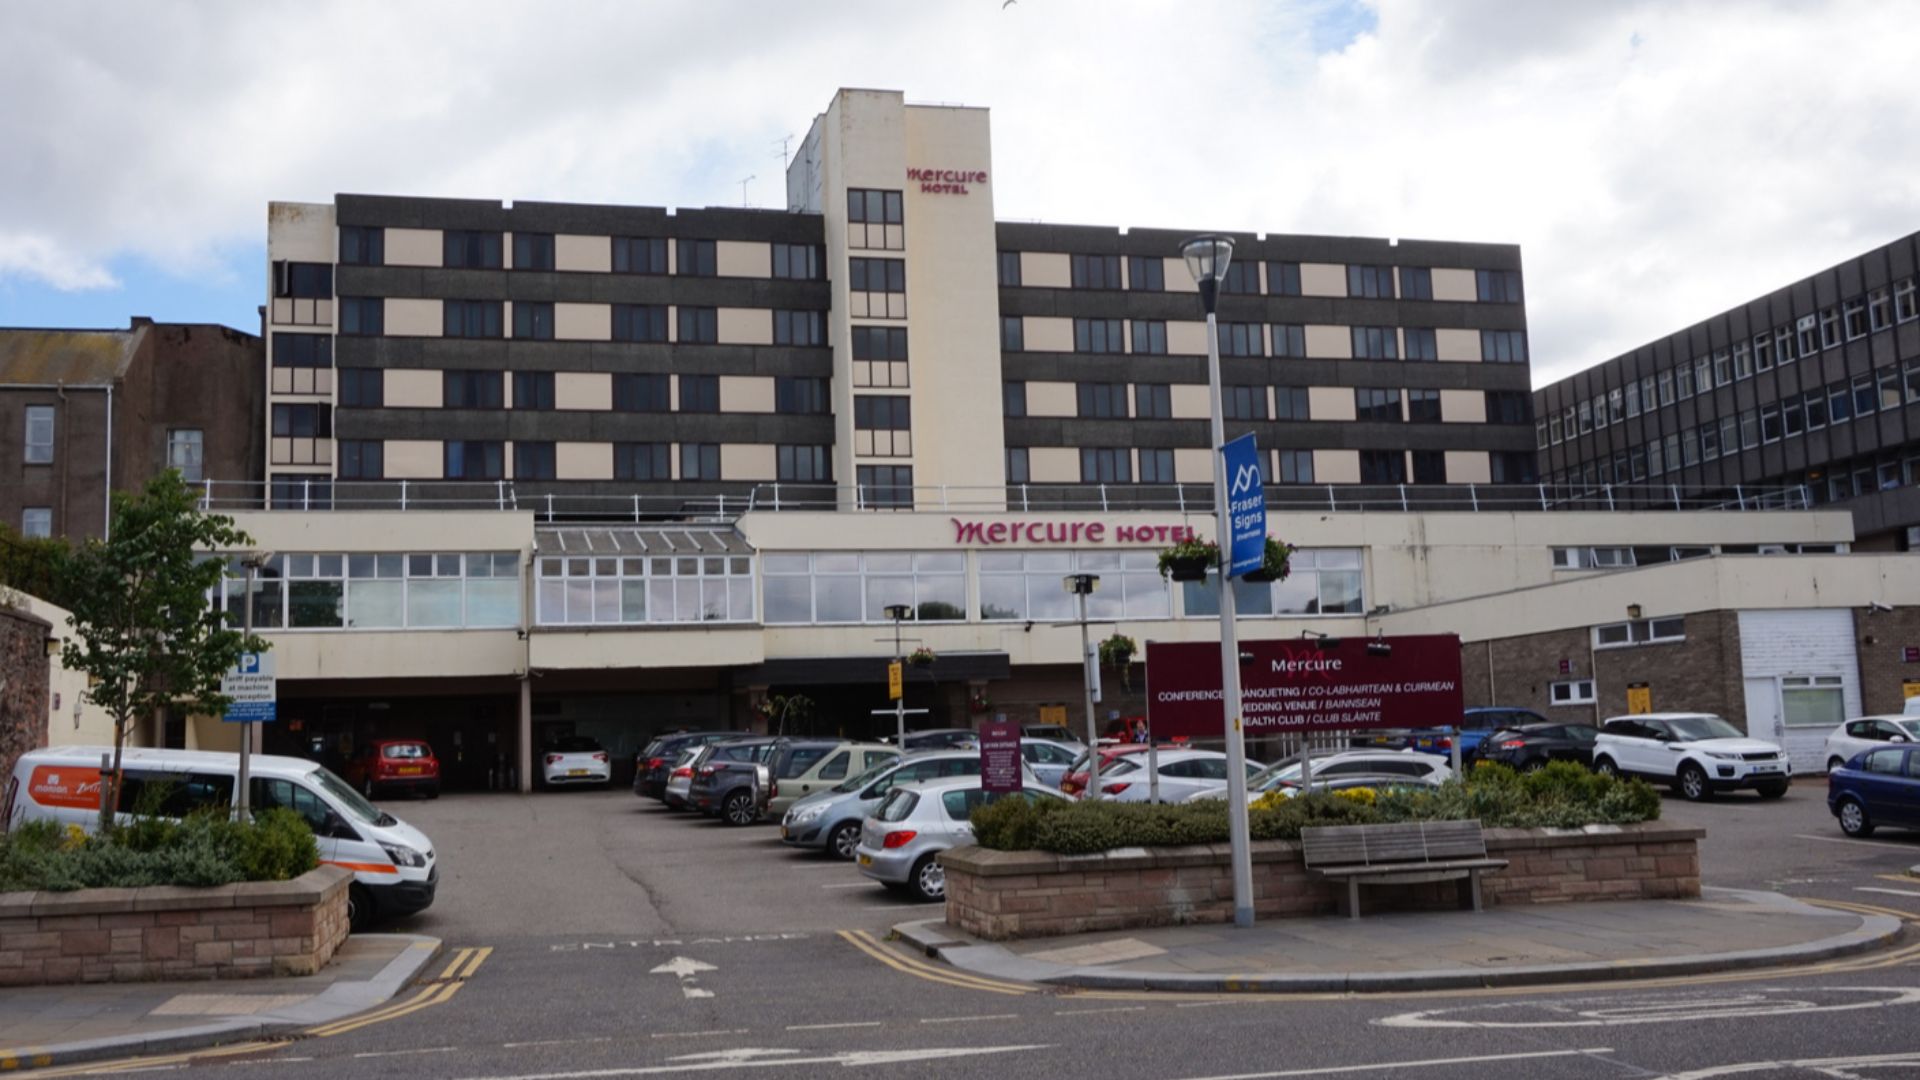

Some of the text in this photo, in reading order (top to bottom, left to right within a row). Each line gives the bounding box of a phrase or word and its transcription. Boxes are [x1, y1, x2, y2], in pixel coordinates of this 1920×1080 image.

[921, 183, 968, 195] HOTEL
[1231, 495, 1262, 513] Fraser
[1235, 511, 1262, 529] Signs
[1271, 659, 1342, 671] Mercure
[244, 675, 273, 683] payable
[1158, 689, 1224, 701] CONFERENCE
[1308, 683, 1393, 696] CO-LABHAIRTEAN
[1395, 683, 1402, 693] &
[1404, 681, 1454, 692] CUIRMEAN
[1284, 701, 1317, 711] VENUE
[1325, 698, 1381, 710] BAINNSEAN
[1278, 714, 1304, 725] CLUB
[1312, 713, 1339, 724] CLUB
